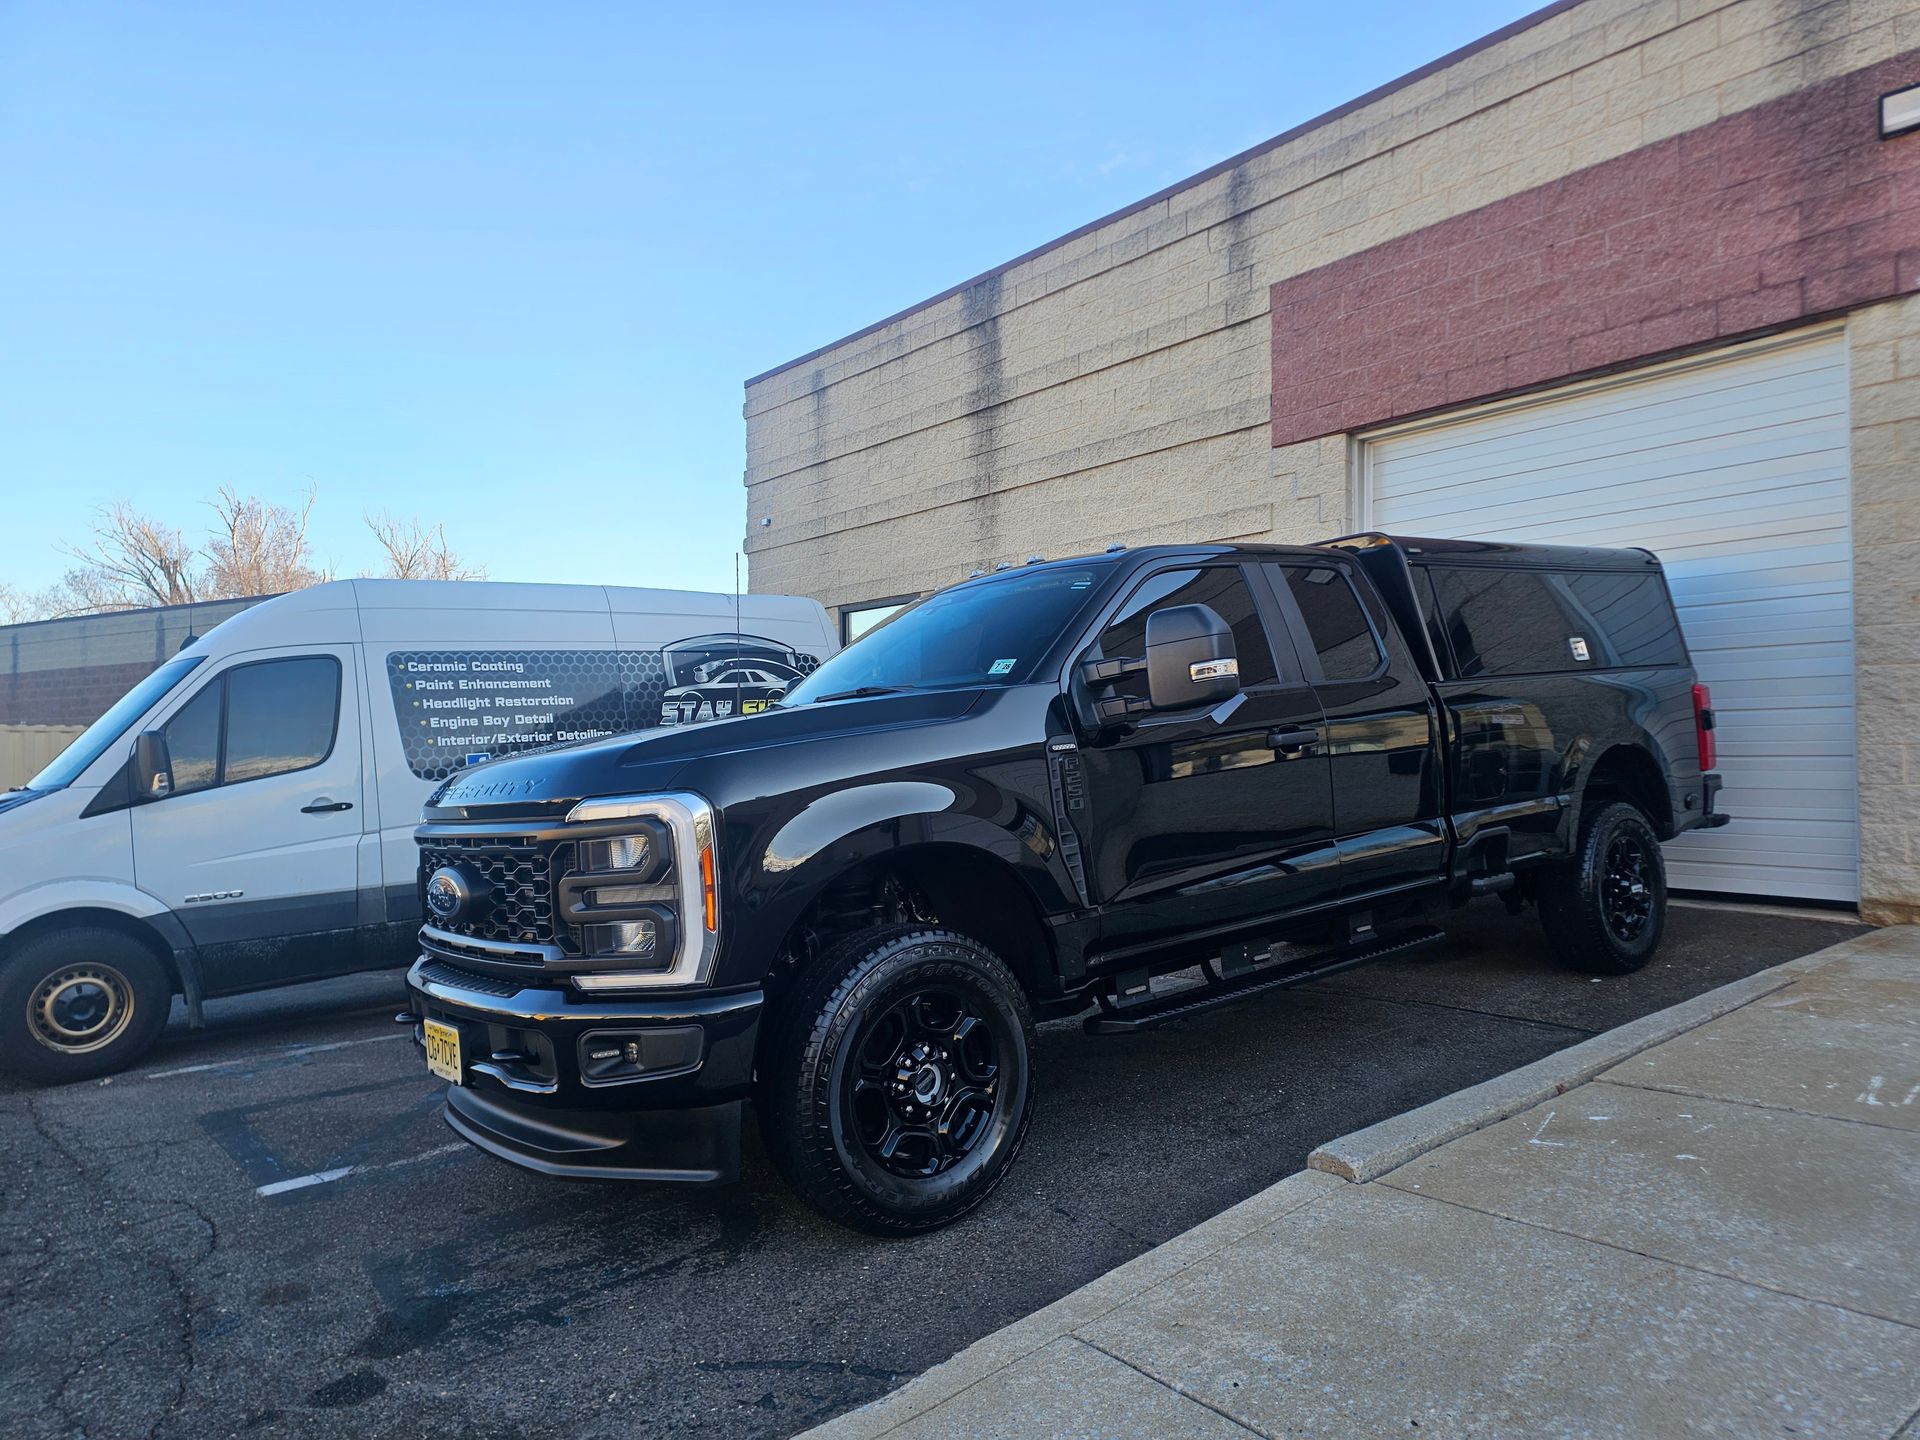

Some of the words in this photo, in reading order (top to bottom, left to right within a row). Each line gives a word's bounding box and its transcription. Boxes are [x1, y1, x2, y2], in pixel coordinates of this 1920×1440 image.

[407, 661, 467, 672] Ceramic
[471, 661, 524, 673] Coating
[415, 680, 454, 690] Paint
[459, 678, 551, 690] Enhancement
[423, 697, 491, 711] Headlight
[495, 695, 574, 708] Restoration
[660, 700, 733, 725] STAY
[430, 716, 479, 729] Engine
[483, 715, 510, 728] Bay
[515, 713, 553, 725] Detail
[437, 731, 553, 747] Interior/Exterior
[184, 890, 243, 903] 2500
